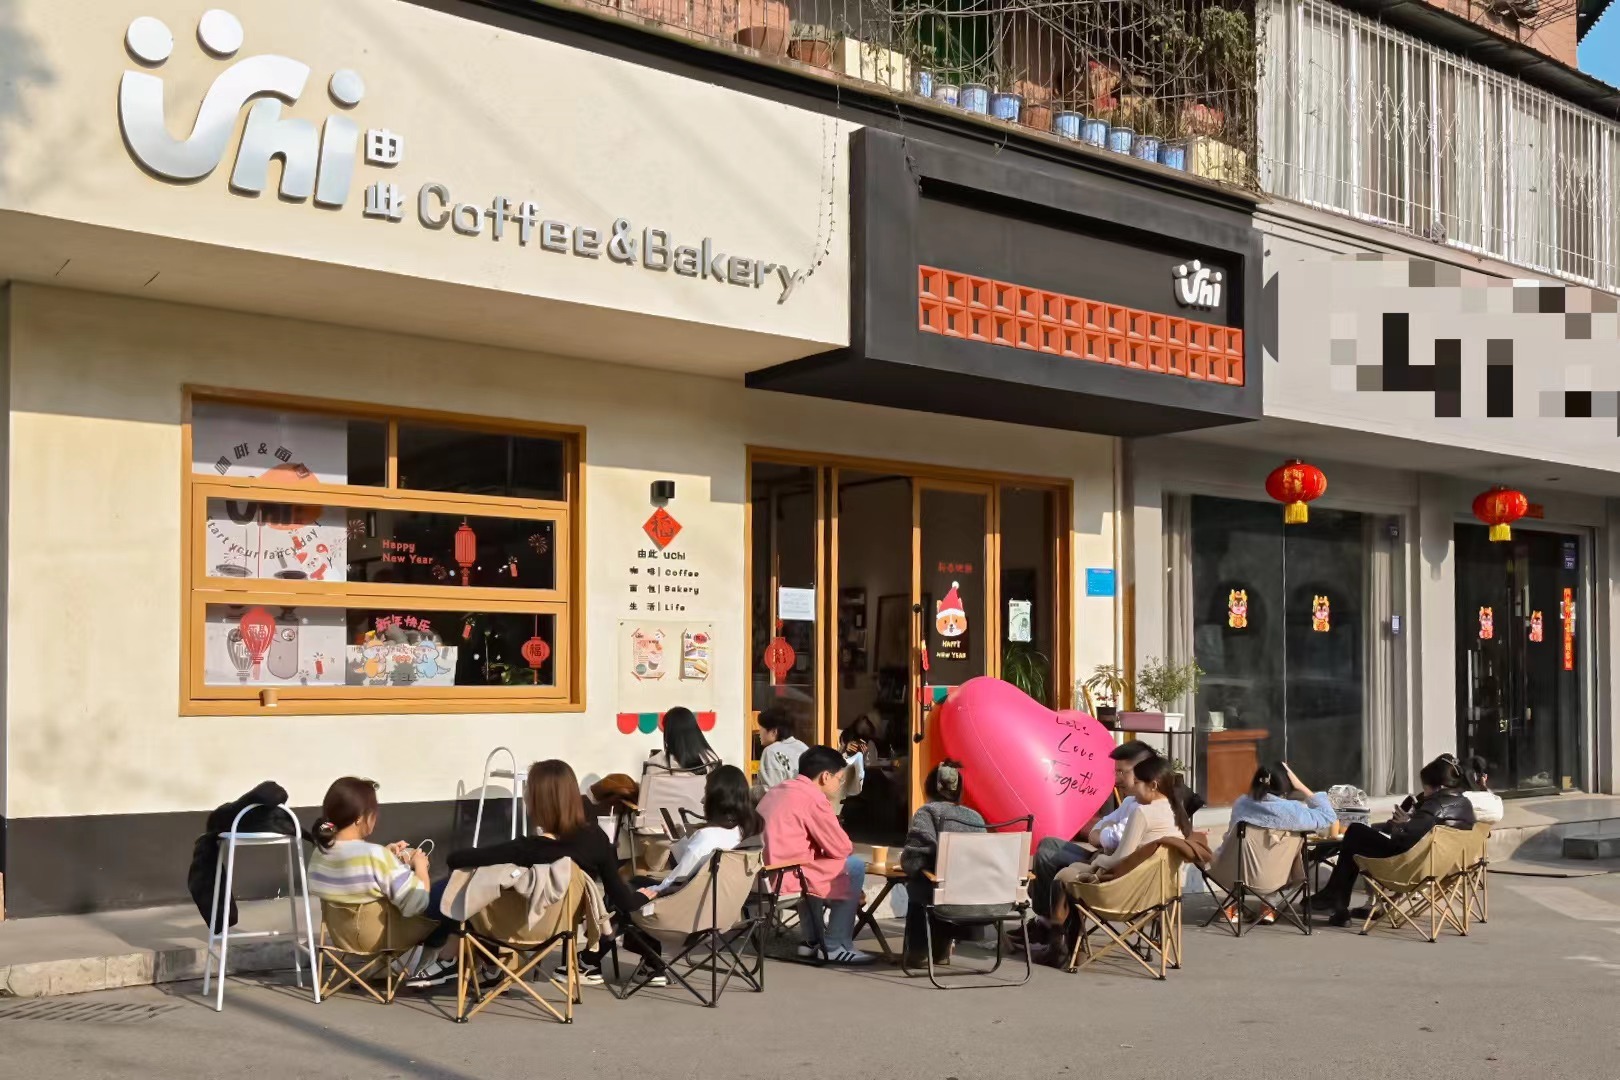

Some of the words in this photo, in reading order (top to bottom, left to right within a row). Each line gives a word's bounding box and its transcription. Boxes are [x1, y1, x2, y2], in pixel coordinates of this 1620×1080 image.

[382, 539, 416, 553] Happy
[382, 553, 406, 563] New
[409, 554, 433, 565] Year
[637, 548, 658, 559] 由此
[664, 569, 699, 578] Coffee
[664, 585, 699, 595] Bakery
[664, 603, 685, 611] Life
[375, 613, 431, 633] 新年快乐
[529, 643, 542, 657] 福
[942, 640, 961, 649] HAPPY
[951, 651, 967, 660] YEAR
[1058, 732, 1094, 760] Love
